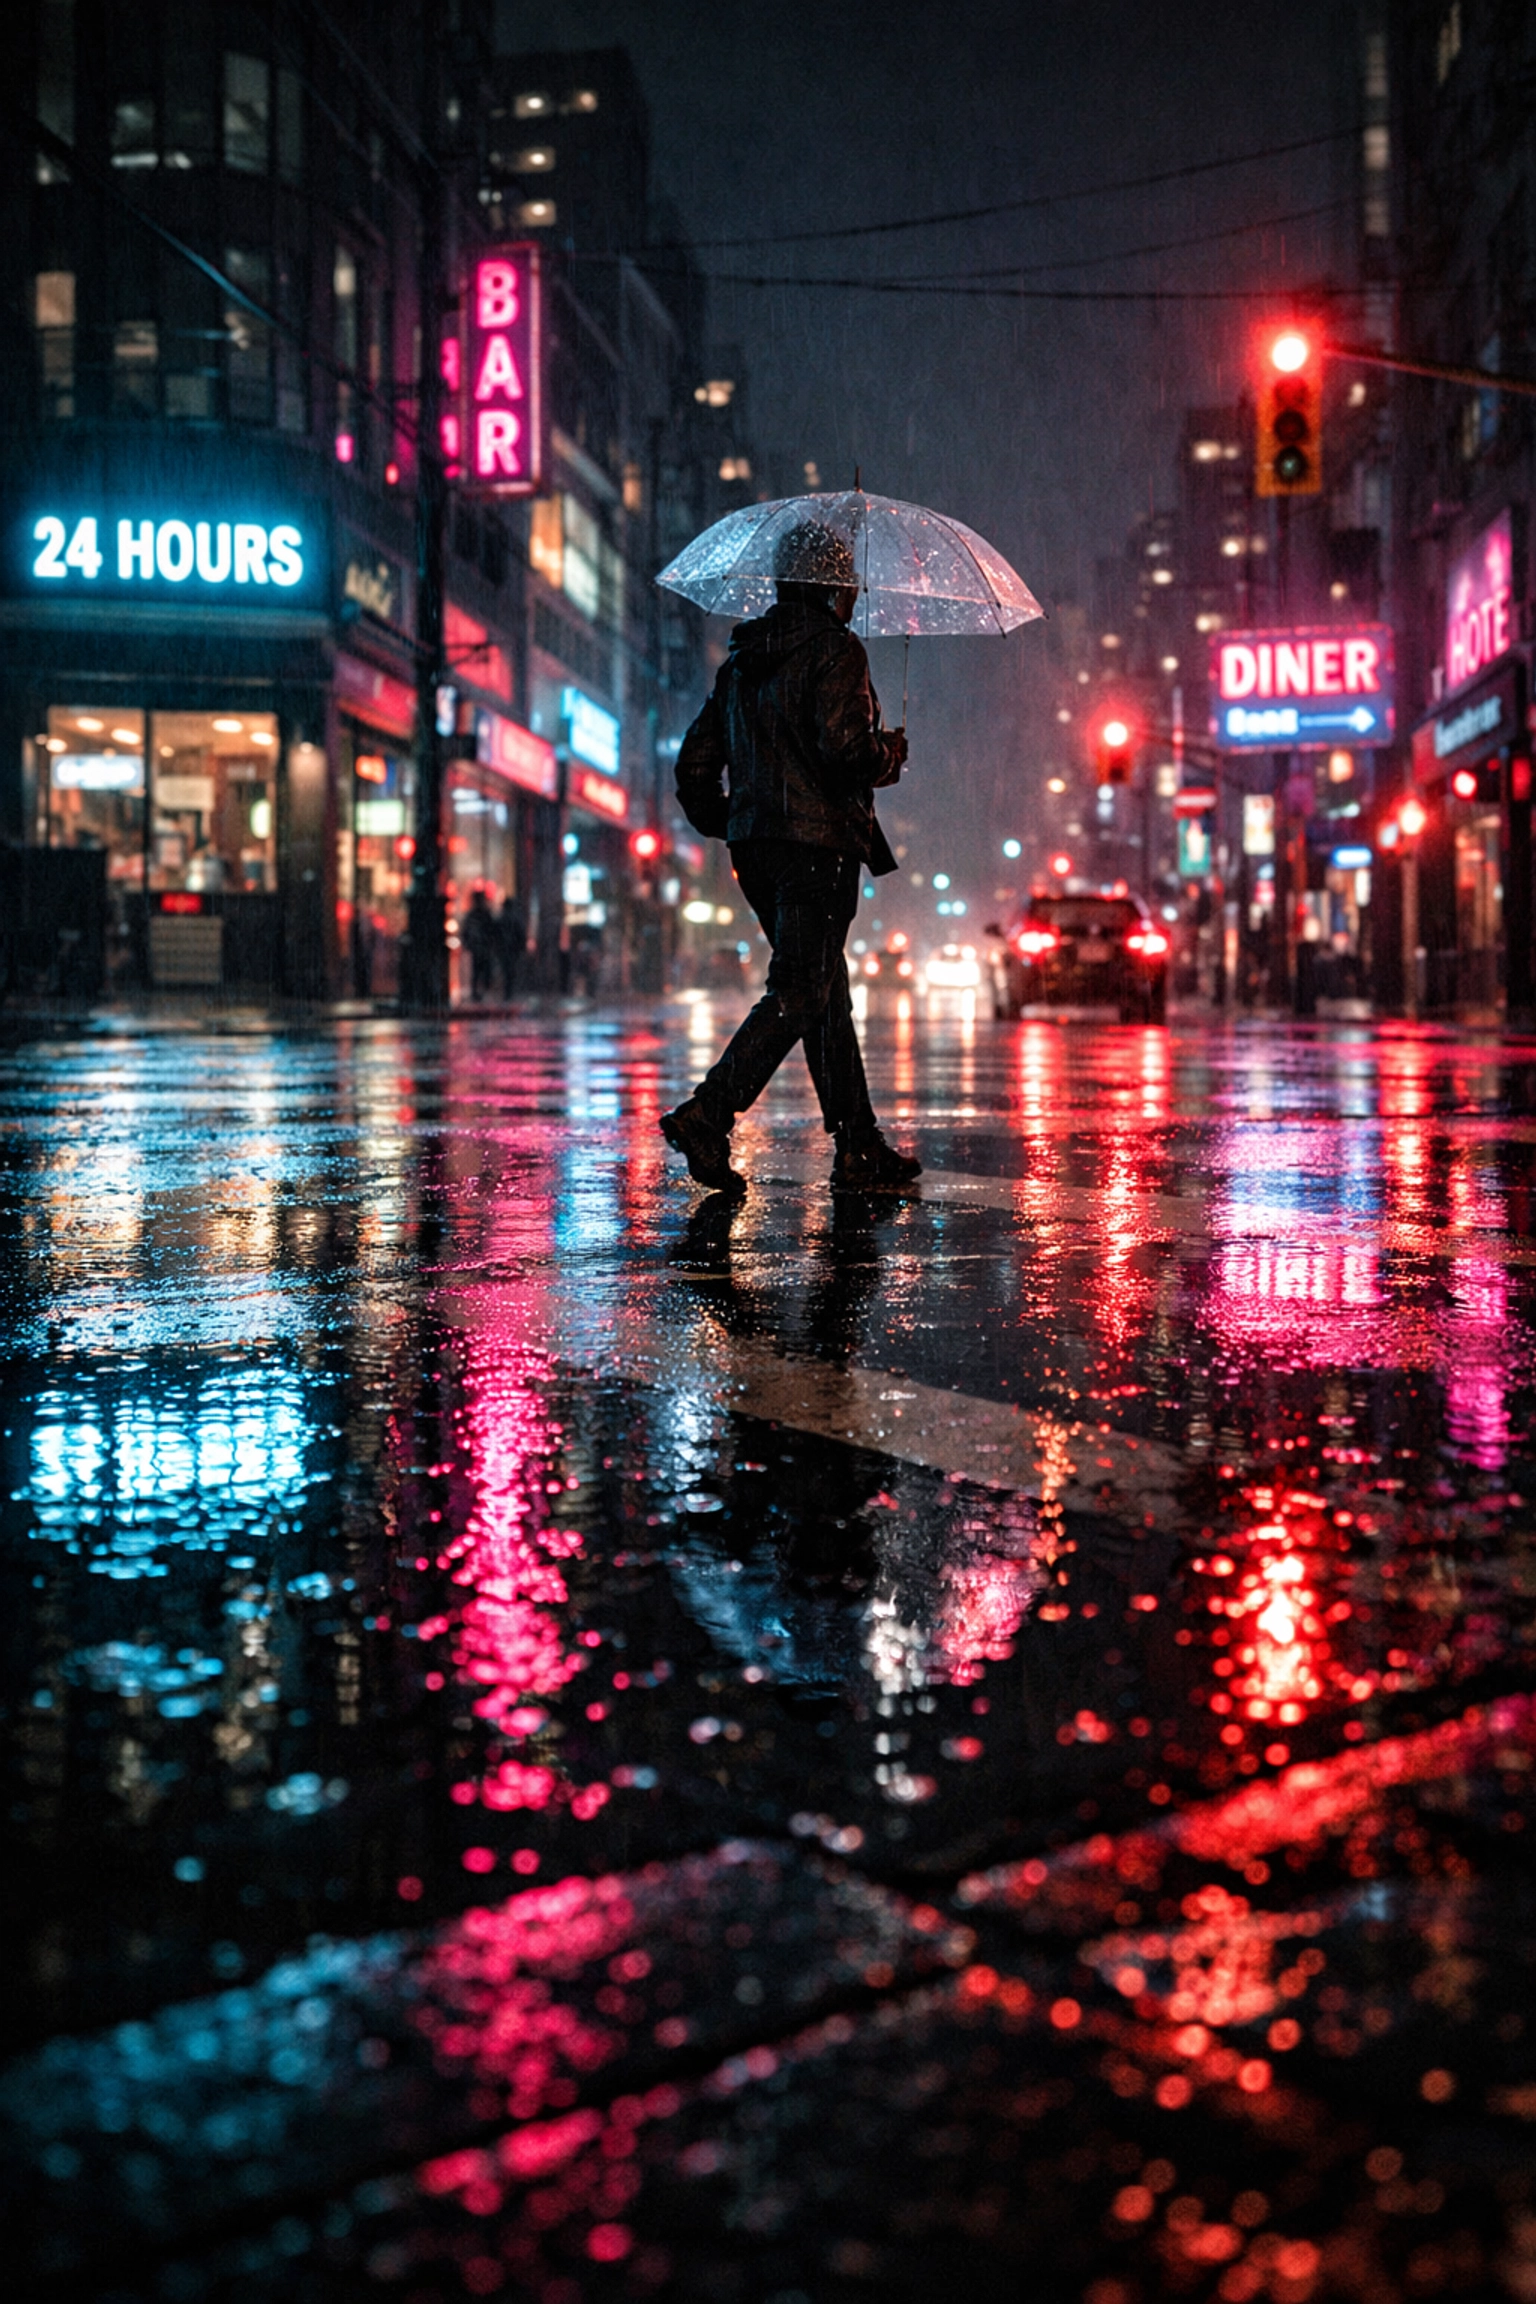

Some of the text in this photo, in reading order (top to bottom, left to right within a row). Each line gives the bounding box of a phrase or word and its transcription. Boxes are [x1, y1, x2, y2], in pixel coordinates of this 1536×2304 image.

[475, 261, 524, 476] BAR
[33, 516, 303, 587] 24 HOURS
[1220, 638, 1381, 700] DINER
